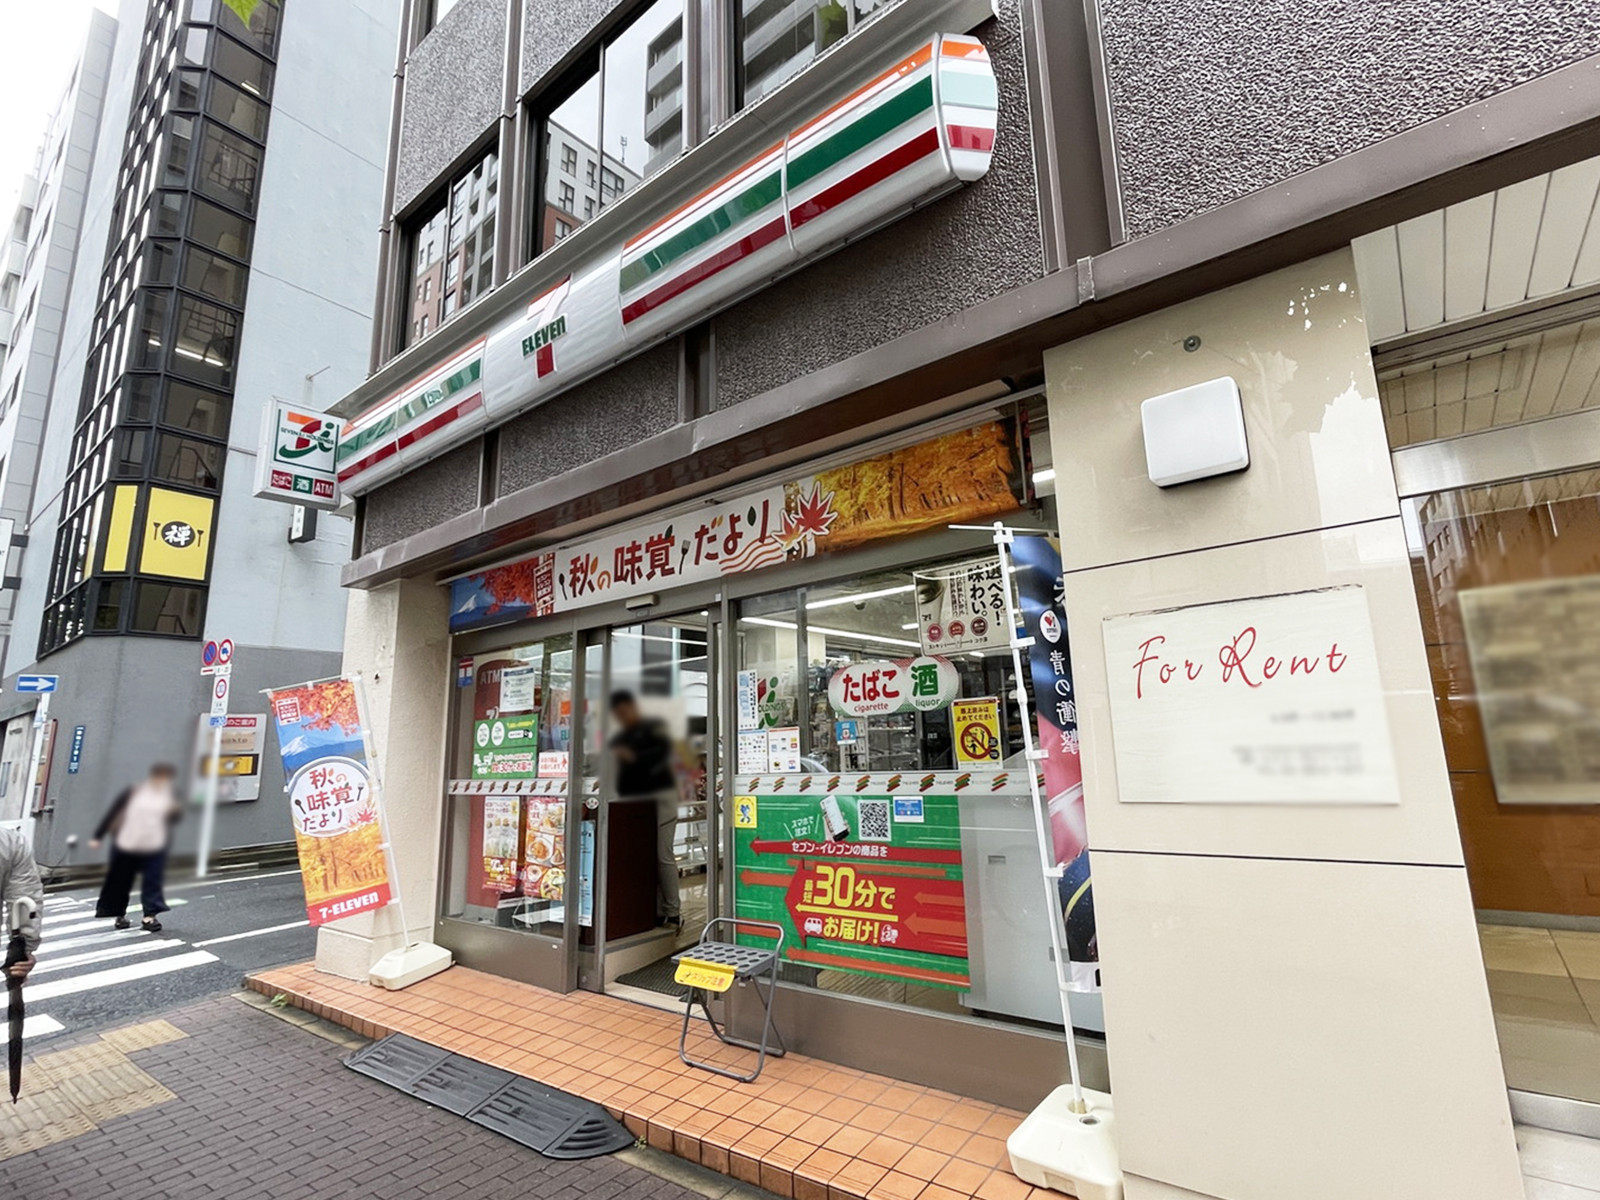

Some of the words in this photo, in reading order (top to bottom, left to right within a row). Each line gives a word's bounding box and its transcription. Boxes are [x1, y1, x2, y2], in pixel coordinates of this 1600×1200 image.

[271, 474, 292, 488] たばこ
[296, 478, 310, 491] 酒
[314, 481, 334, 496] ATM
[1133, 635, 1203, 699] For
[1219, 626, 1347, 688] Rent
[843, 669, 900, 703] たばこ
[911, 664, 939, 697] 酒
[757, 701, 787, 712] OLDINGS
[854, 702, 889, 713] cigarette
[915, 699, 940, 708] liquor
[309, 767, 347, 789] 秋の
[306, 784, 355, 811] 味覚
[302, 809, 343, 832] だより
[791, 815, 814, 829] スマホで
[823, 916, 880, 944] お届け!
